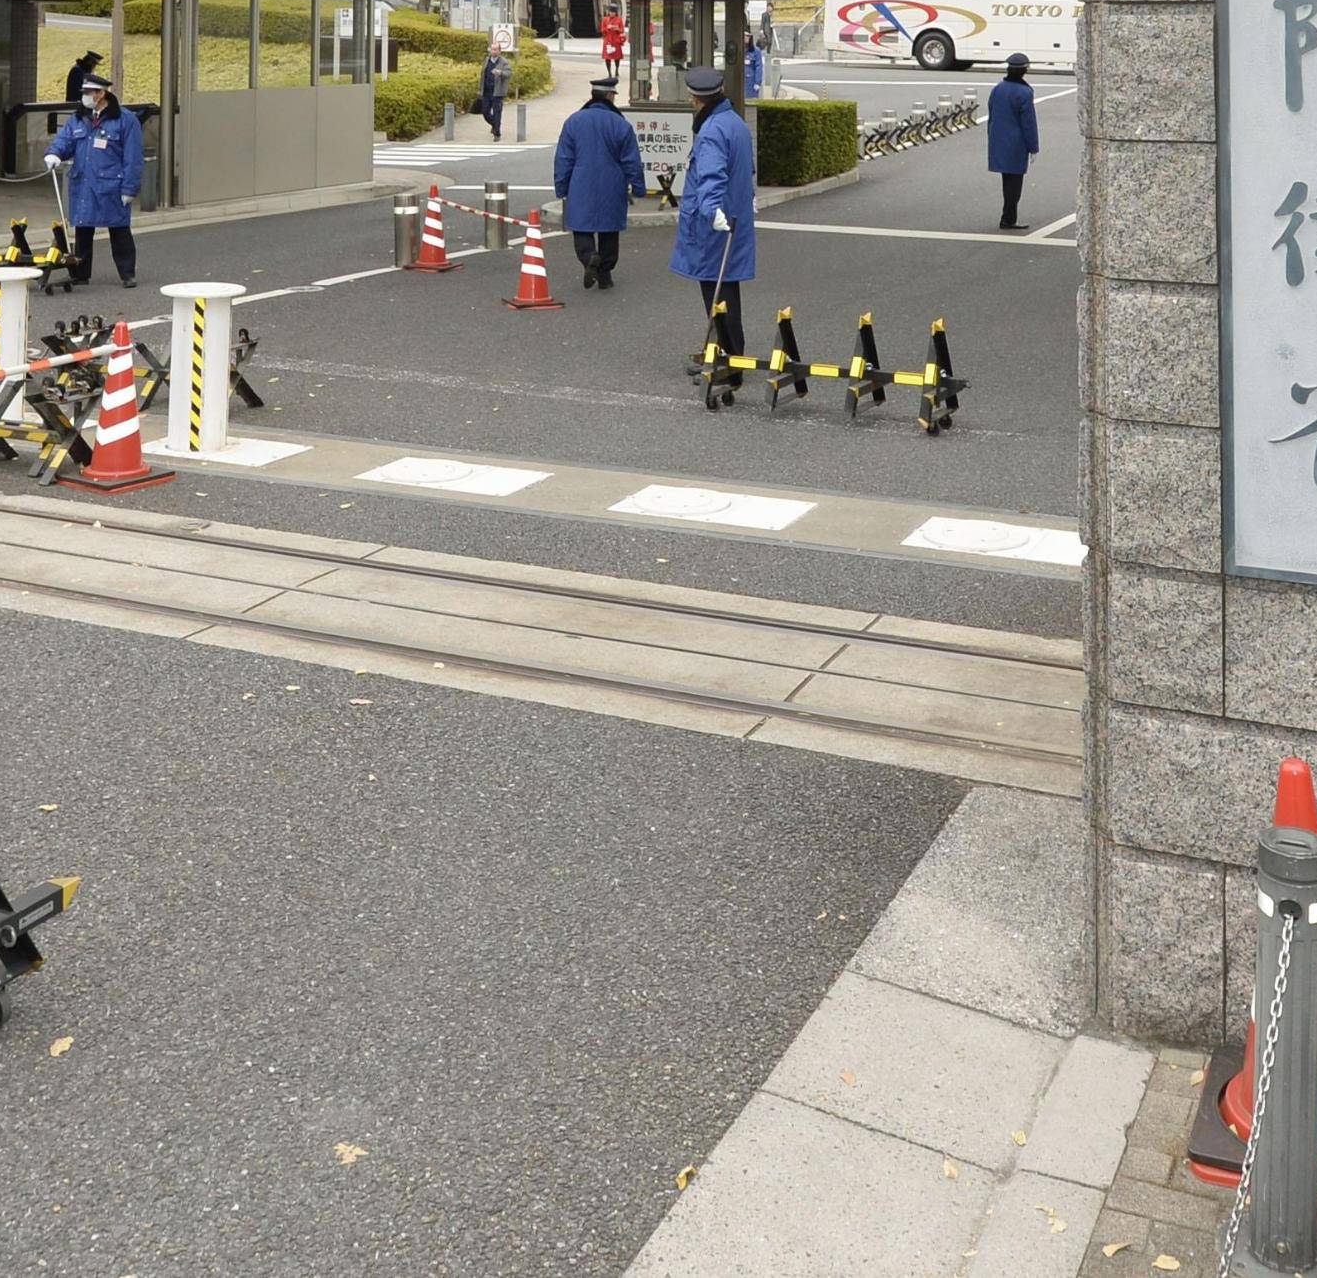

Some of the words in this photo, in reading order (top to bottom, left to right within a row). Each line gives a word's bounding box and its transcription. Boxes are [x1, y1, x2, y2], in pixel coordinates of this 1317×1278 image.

[991, 4, 1063, 18] TOKYO
[636, 121, 671, 131] 時停止
[637, 133, 688, 143] 備員の指示に
[637, 144, 682, 153] ってください
